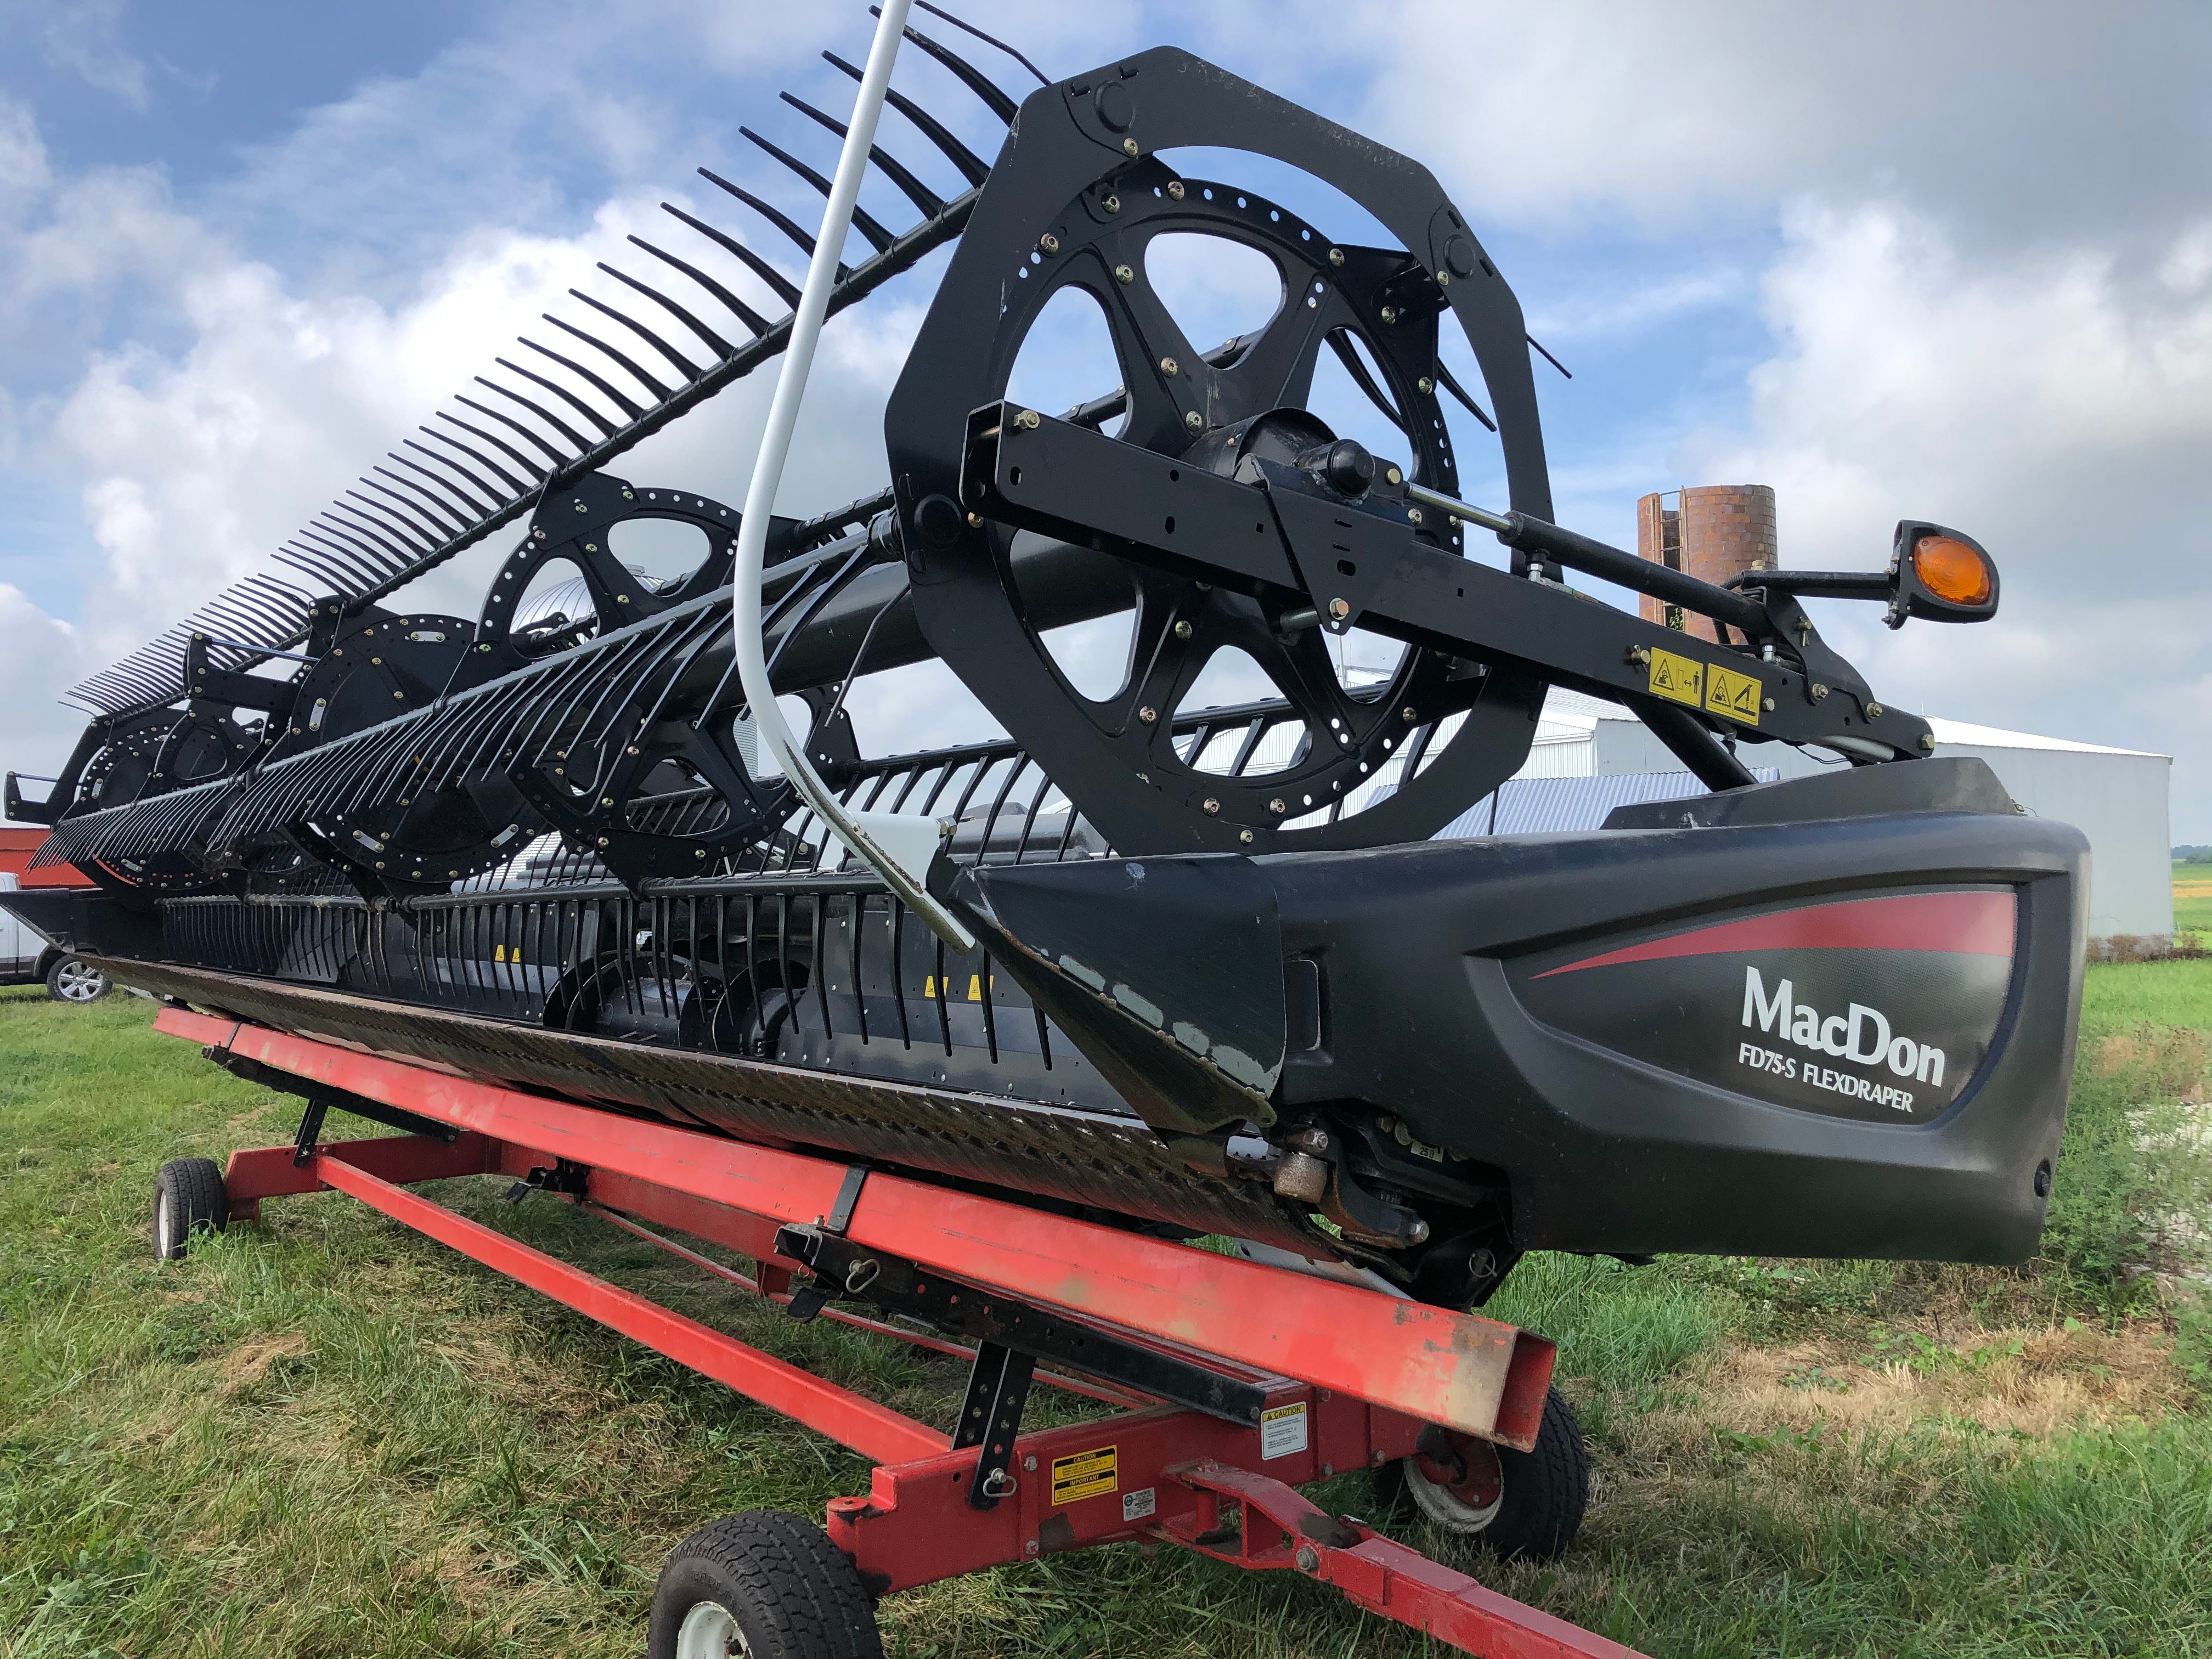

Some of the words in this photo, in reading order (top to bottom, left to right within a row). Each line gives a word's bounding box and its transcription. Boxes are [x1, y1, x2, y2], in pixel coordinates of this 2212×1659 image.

[1742, 966, 1945, 1087] MacDon
[1739, 1042, 1797, 1079] FD75-S
[1803, 1062, 1914, 1113] FLEXDRAPER
[1274, 1406, 1301, 1418] CAUTION
[1073, 1453, 1096, 1463] CAUTION
[1069, 1474, 1100, 1486] IMPORTANT
